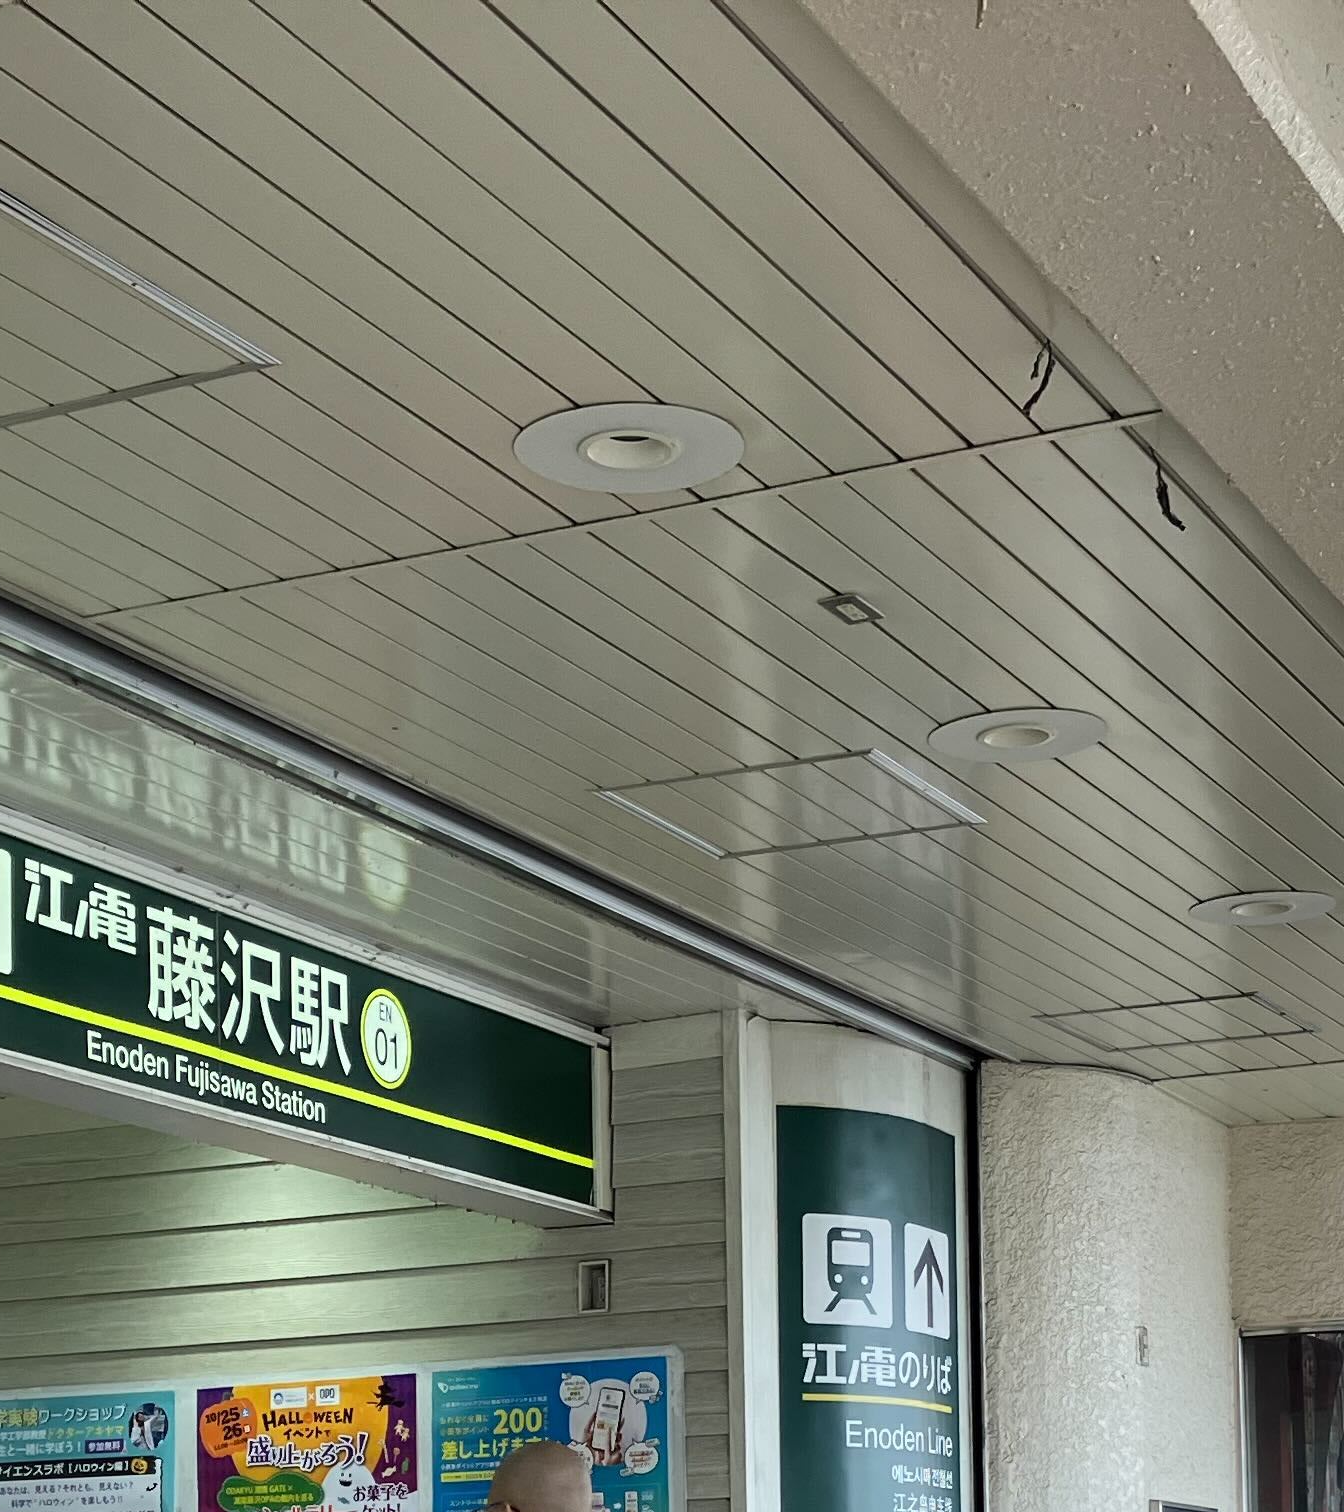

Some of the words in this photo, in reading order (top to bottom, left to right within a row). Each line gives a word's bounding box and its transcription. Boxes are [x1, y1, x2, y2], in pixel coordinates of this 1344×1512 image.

[146, 904, 352, 1076] 藤沢駅
[378, 1002, 392, 1025] EN
[375, 1027, 400, 1070] 01
[87, 1029, 169, 1081] Enoden
[175, 1054, 258, 1106] Fujisawa
[261, 1080, 326, 1125] Station
[206, 1407, 240, 1425] 10/25
[494, 1406, 543, 1435] 200
[223, 1423, 242, 1441] 26
[845, 1419, 925, 1452] Enoden
[927, 1427, 953, 1457] Line
[353, 1483, 409, 1501] お菓子を
